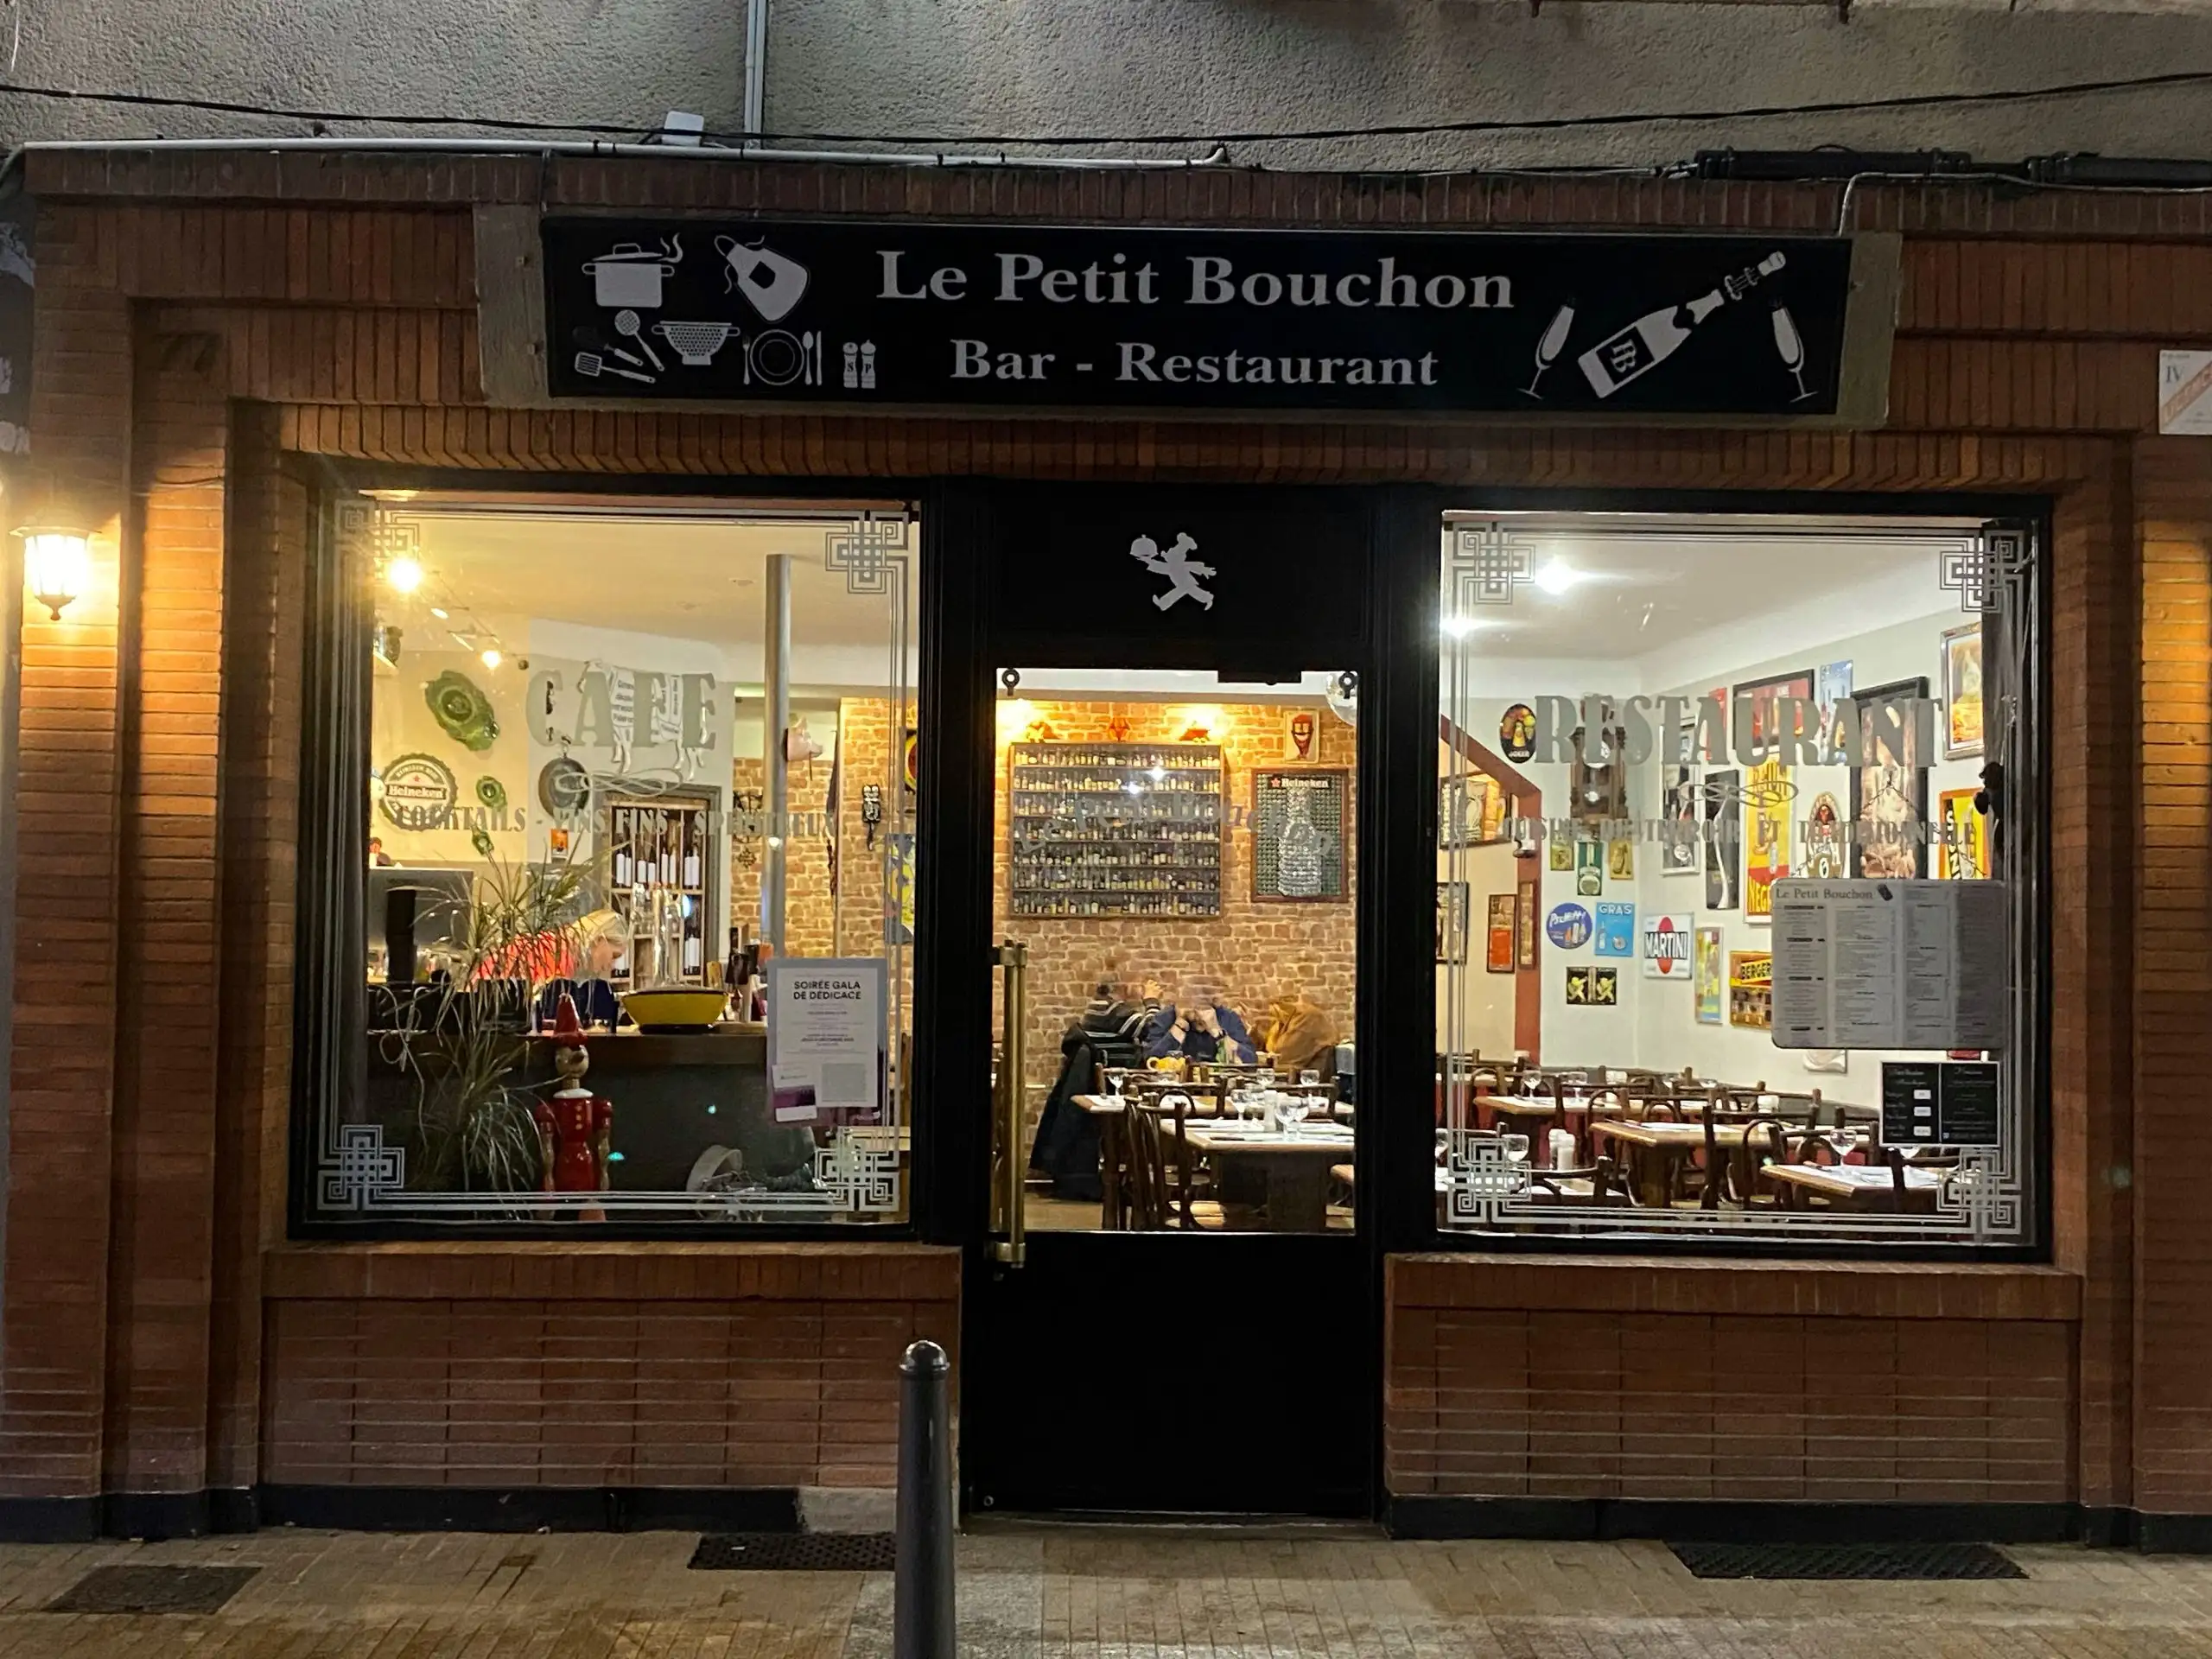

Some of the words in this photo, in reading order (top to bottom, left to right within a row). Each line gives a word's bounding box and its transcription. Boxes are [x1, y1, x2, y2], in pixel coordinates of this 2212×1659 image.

[875, 250, 968, 301] Le
[994, 252, 1160, 304] Petit
[1183, 256, 1516, 308] Bouchon
[950, 339, 1056, 380] Bar
[1115, 341, 1440, 386] Restaurant
[525, 669, 716, 750] CAFE
[1534, 694, 1944, 767] RESTAURANT
[389, 785, 444, 798] Heineken
[1281, 778, 1330, 788] Heineken
[396, 805, 526, 832] COCKTAILS
[615, 807, 669, 835] FINS
[1776, 888, 1789, 899] Le
[1794, 887, 1819, 899] Petit
[1824, 888, 1873, 900] Bouchon
[1599, 904, 1632, 915] GRAS
[1645, 931, 1688, 959] MARTINI
[794, 980, 830, 990] SOIRÉE
[832, 981, 861, 990] GALA
[793, 991, 807, 1000] DE
